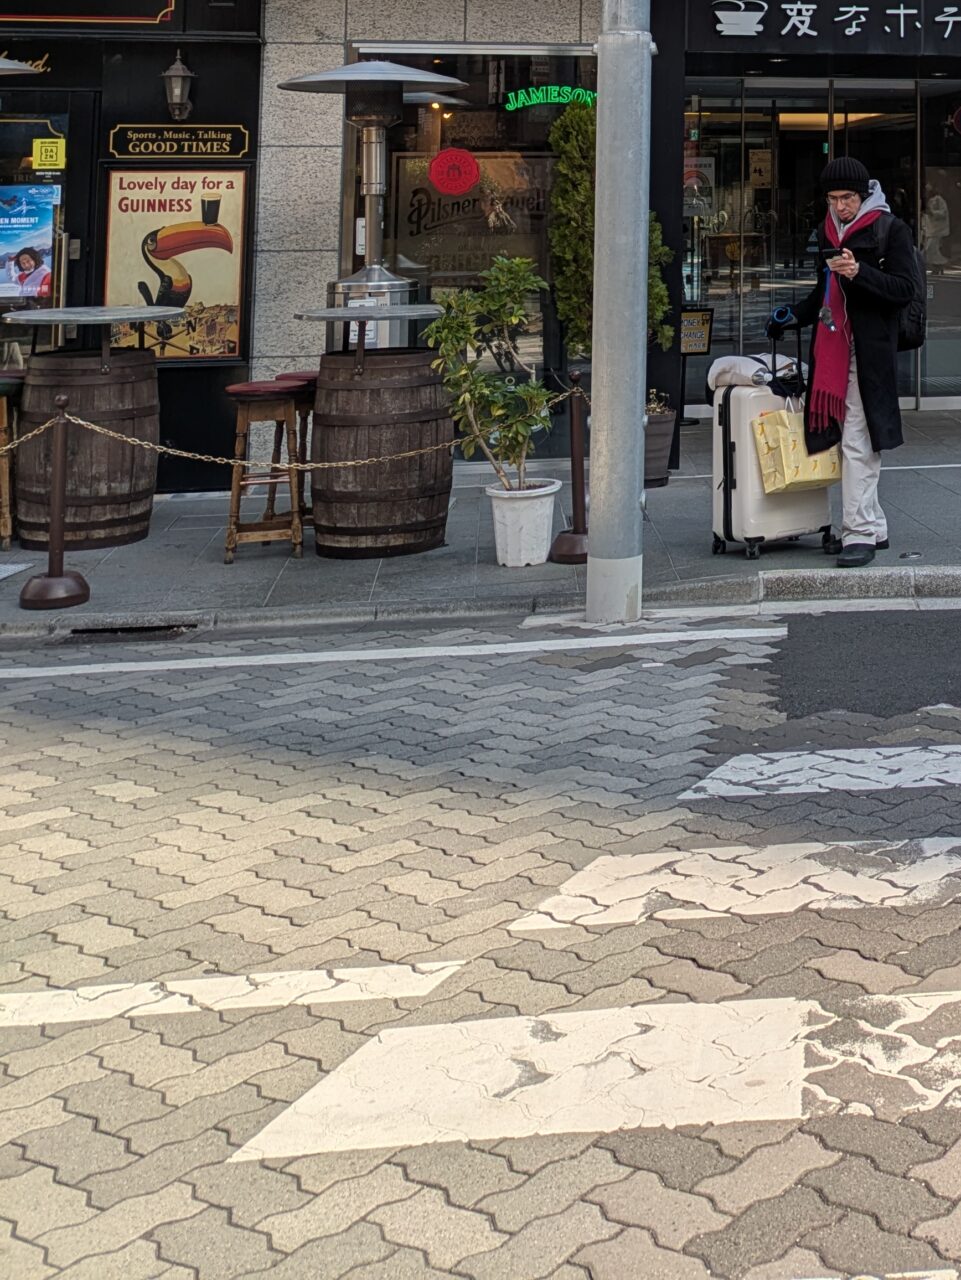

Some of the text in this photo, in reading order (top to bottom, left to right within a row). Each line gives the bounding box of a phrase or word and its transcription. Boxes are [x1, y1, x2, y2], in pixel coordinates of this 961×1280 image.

[197, 130, 232, 141] Talking
[128, 141, 230, 153] GOOD TIMES
[118, 176, 235, 194] Lovely day for a
[118, 197, 193, 213] GUINNESS
[407, 187, 482, 237] Pilsner
